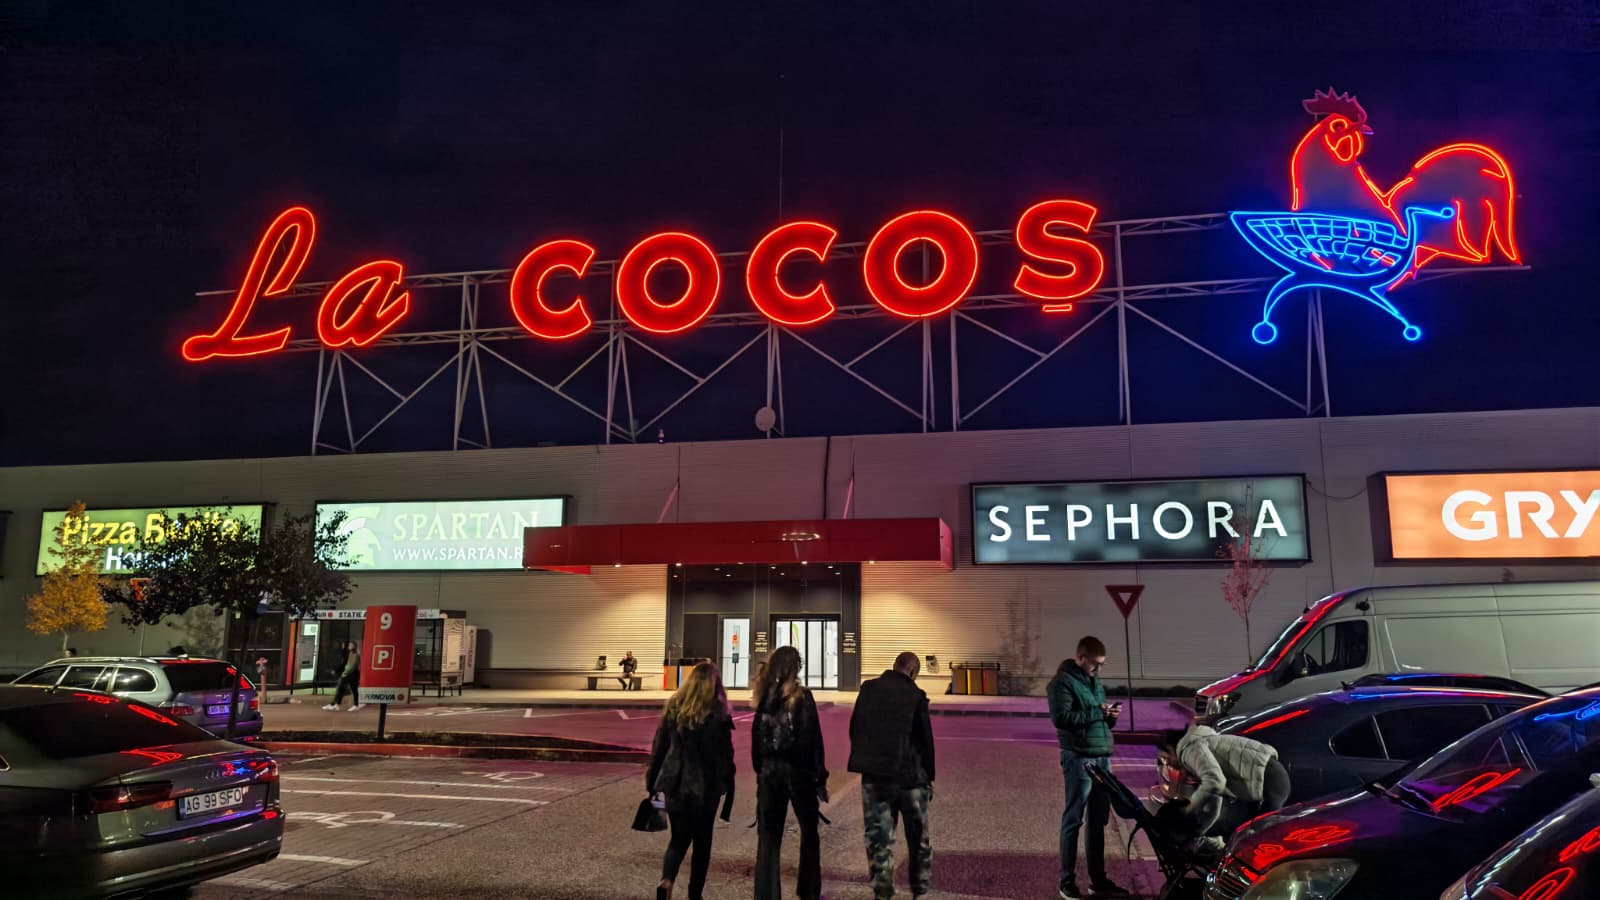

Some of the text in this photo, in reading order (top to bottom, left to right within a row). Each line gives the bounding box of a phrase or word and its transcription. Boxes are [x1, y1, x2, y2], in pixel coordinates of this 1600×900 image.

[182, 207, 410, 361] La
[62, 514, 136, 545] Pizza
[393, 511, 538, 541] SPARTAN
[988, 499, 1289, 542] SEPHORA
[380, 612, 393, 630] 9
[377, 650, 389, 664] P
[186, 788, 242, 813] AG 99 SFO
